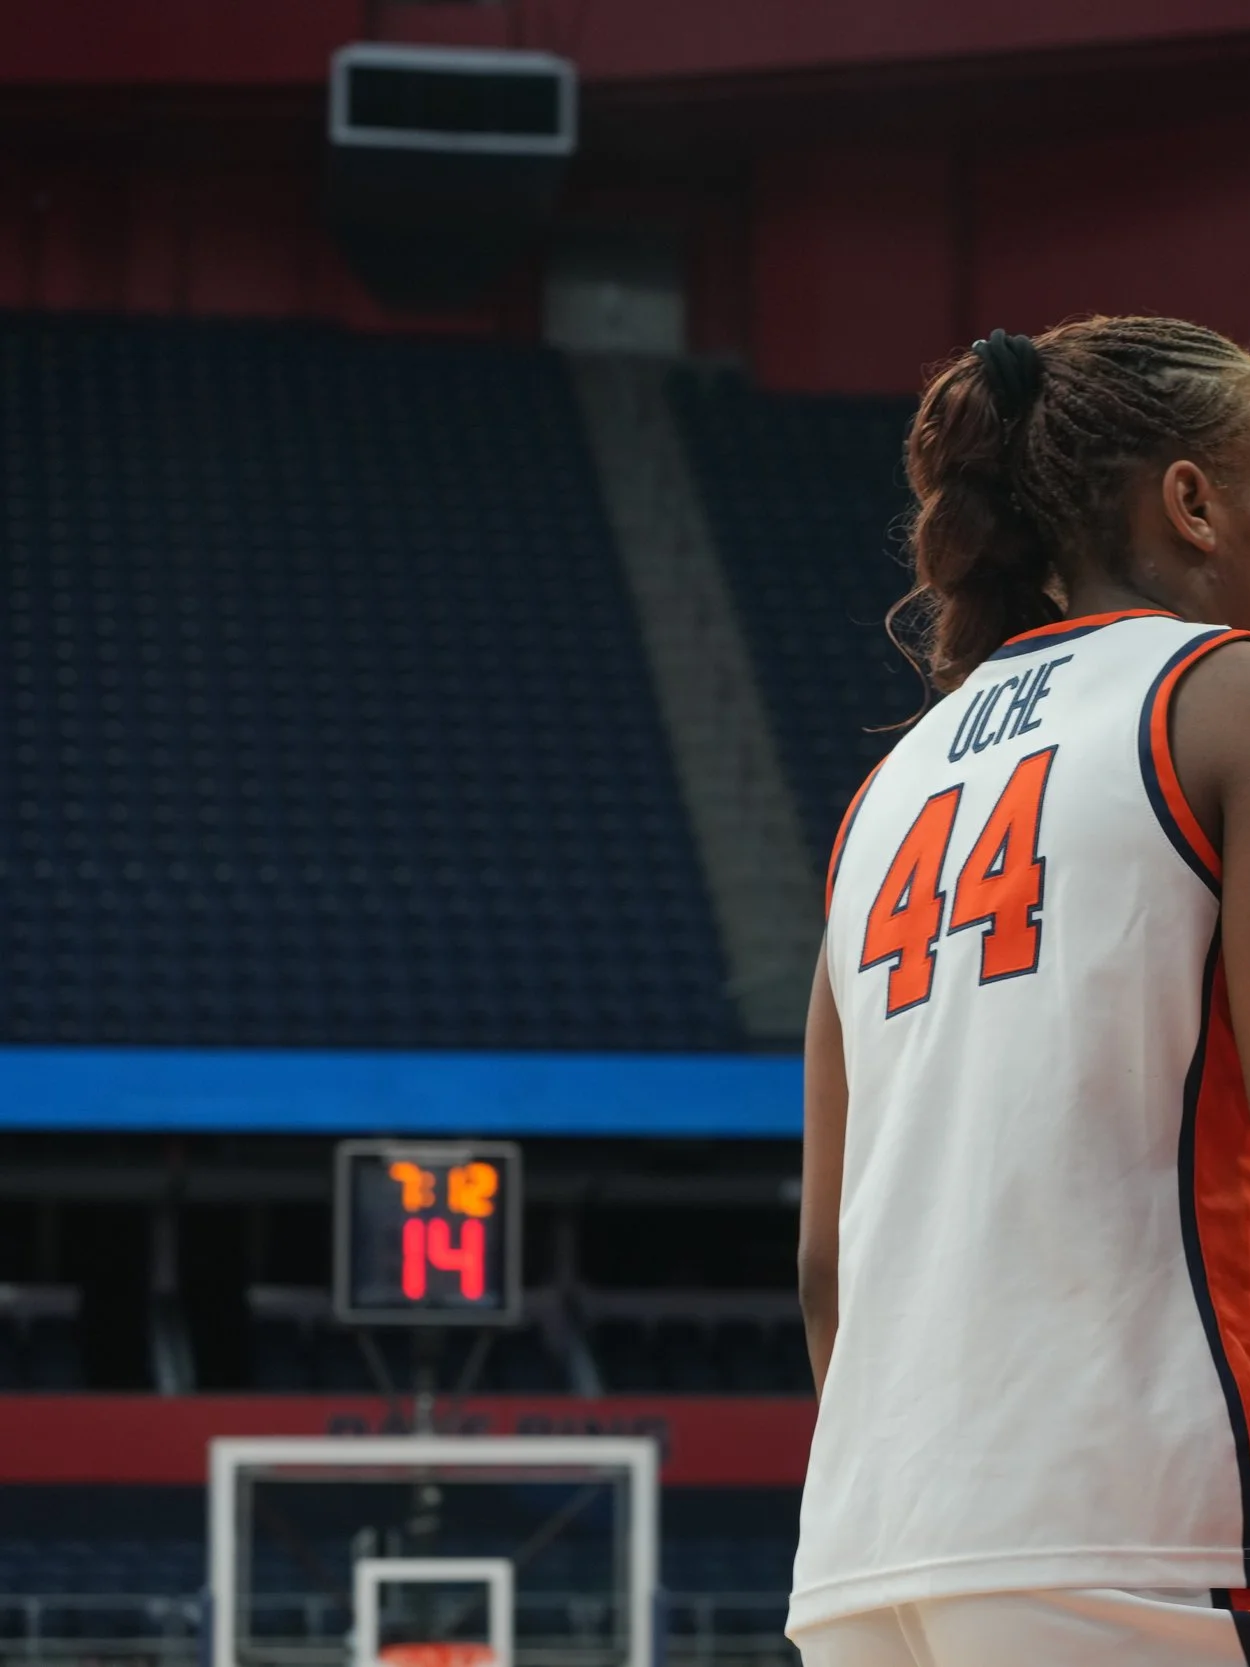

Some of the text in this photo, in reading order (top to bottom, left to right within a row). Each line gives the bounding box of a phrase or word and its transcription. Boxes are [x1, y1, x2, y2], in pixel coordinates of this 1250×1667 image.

[947, 654, 1074, 763] UCHE
[858, 744, 1060, 1020] 44
[389, 1161, 498, 1218] 7:12
[402, 1217, 486, 1300] 14
